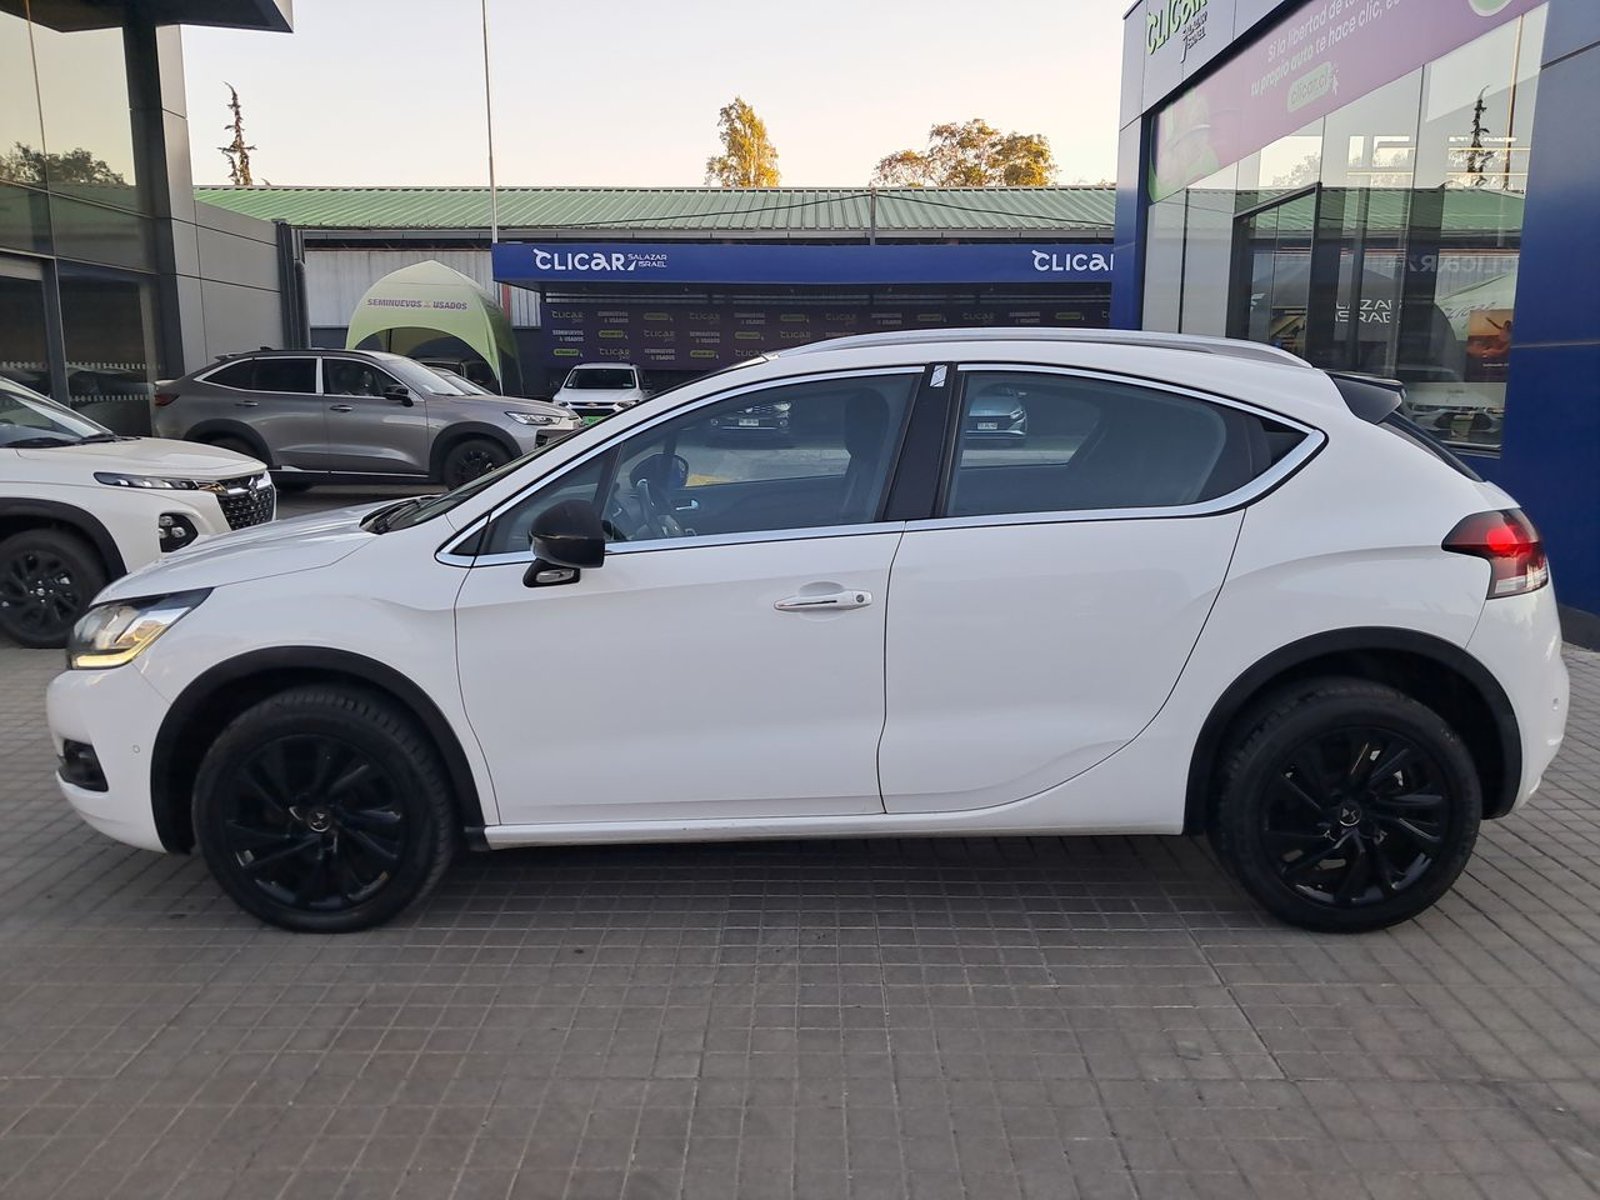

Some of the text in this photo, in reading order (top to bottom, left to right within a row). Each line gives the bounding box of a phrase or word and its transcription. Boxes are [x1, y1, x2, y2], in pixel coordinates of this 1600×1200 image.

[1287, 4, 1327, 45] libertad
[1328, 16, 1356, 48] hace
[628, 253, 668, 261] SALAZAR
[638, 260, 667, 268] ISRAEL
[367, 298, 422, 308] SEMINUEVOS
[433, 301, 468, 310] USADOS
